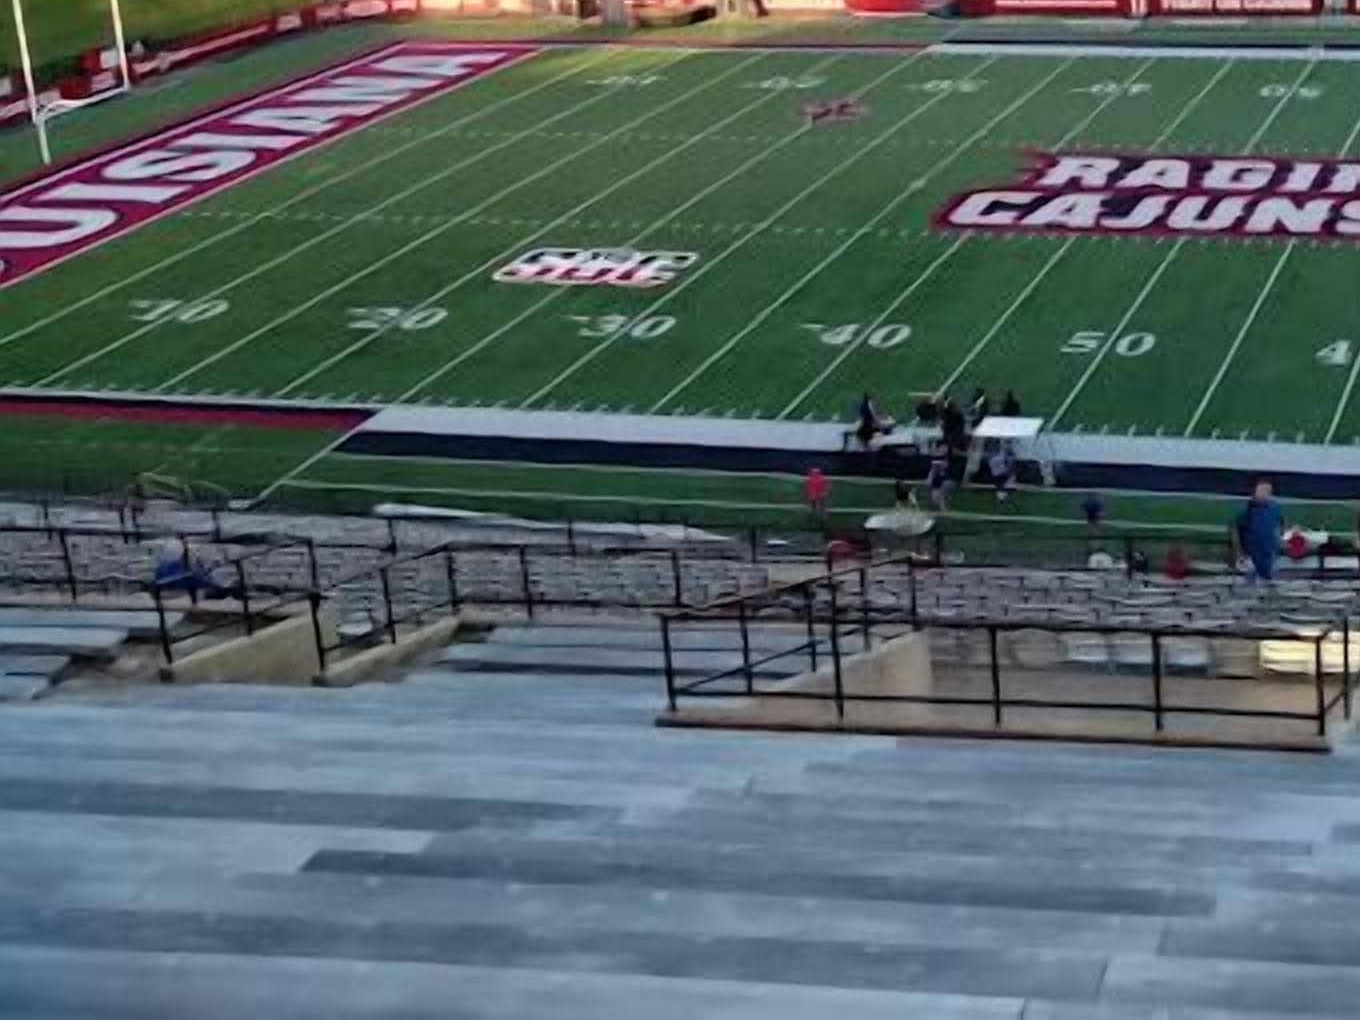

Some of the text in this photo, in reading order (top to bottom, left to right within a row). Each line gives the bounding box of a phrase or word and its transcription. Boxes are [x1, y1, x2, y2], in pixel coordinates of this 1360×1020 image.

[0, 52, 508, 272] UISIANA
[818, 323, 912, 349] 40
[1060, 331, 1156, 356] 50
